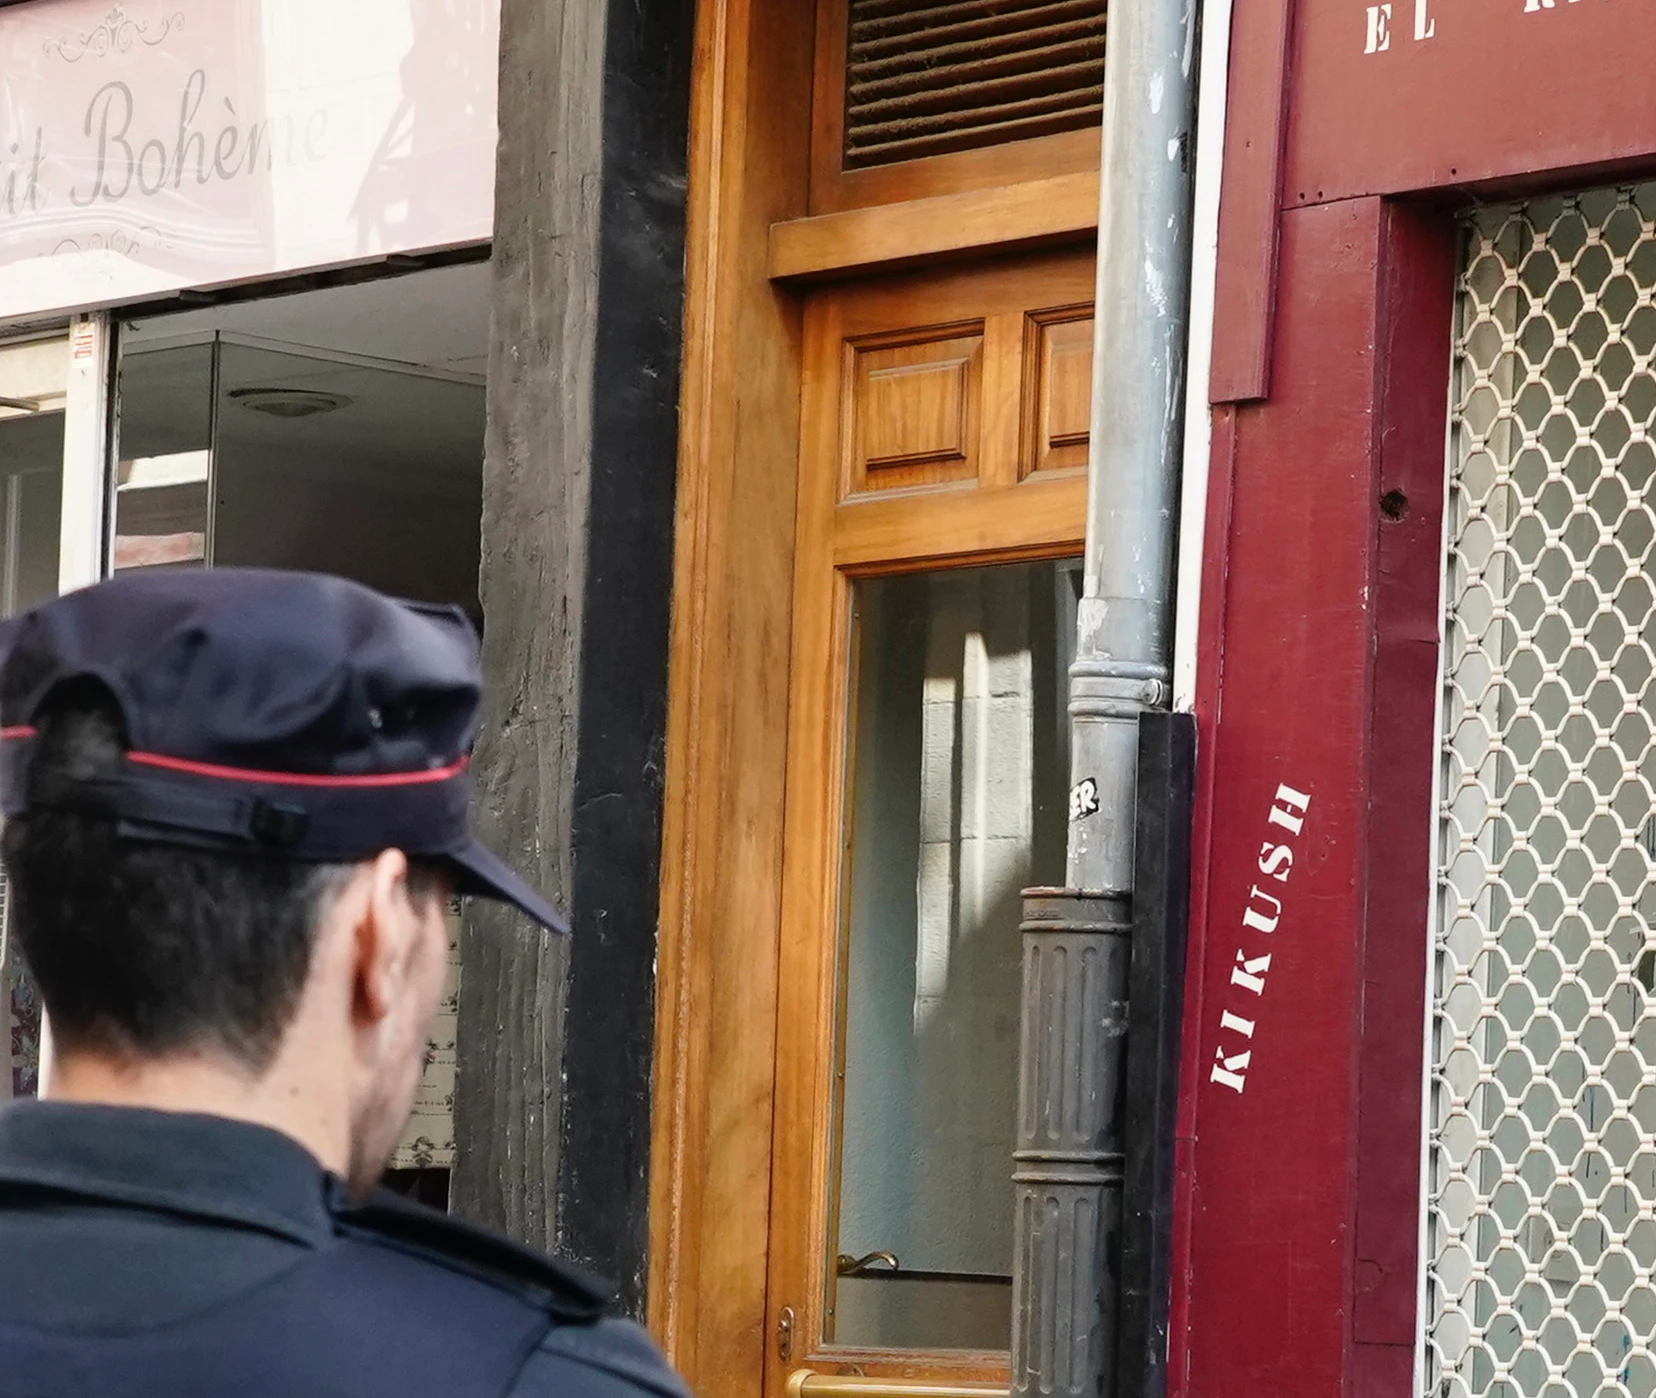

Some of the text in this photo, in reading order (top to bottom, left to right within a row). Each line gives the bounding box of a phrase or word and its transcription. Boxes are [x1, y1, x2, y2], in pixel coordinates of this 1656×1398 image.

[1364, 0, 1435, 54] EL
[70, 69, 330, 207] Bohème
[1210, 783, 1311, 1093] KIKUSH
